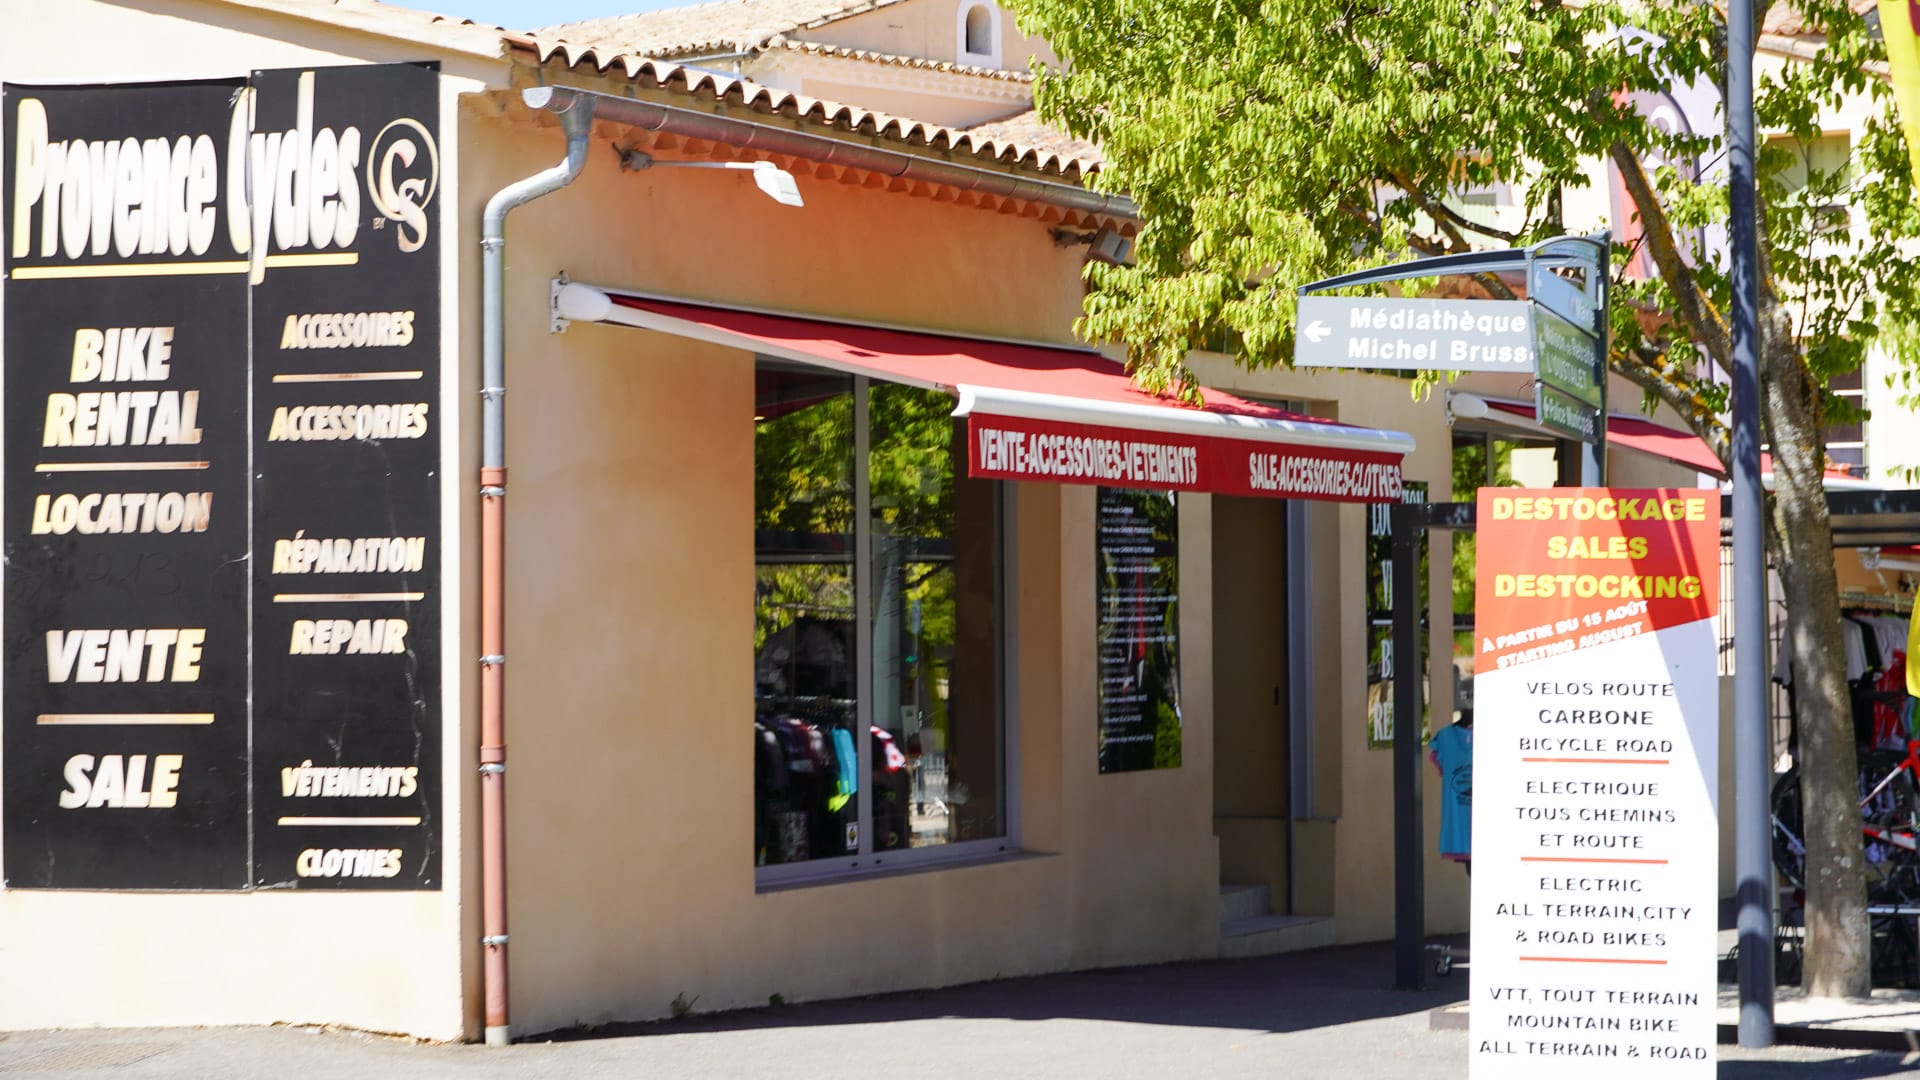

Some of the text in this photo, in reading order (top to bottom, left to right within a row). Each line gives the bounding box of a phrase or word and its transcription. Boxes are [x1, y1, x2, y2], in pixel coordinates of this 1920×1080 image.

[12, 71, 361, 285] Provence Cycles
[280, 311, 415, 350] ACCESSOIRES
[1349, 307, 1526, 337] Médiathèque
[70, 326, 175, 383] BIKE
[1347, 337, 1534, 363] Michel Bruss
[42, 390, 203, 448] RENTAL
[268, 402, 429, 442] ACCESSORIES
[31, 492, 213, 535] LOCATION
[1492, 497, 1706, 521] DESTOCKAGE
[272, 530, 426, 574] RÉPARATION
[1547, 535, 1649, 559] SALES
[1494, 574, 1701, 599] DESTOCKING
[289, 619, 409, 655] REPAIR
[1496, 624, 1555, 649] PARTIR
[1555, 617, 1579, 635] DU
[1582, 611, 1602, 627] 15
[1605, 600, 1648, 622] AOÛT
[46, 628, 206, 683] VENTE
[1496, 620, 1644, 669] STARTING AUGUST
[1527, 682, 1675, 697] VELOS ROUTE
[1538, 709, 1654, 726] CARBONE
[1519, 737, 1673, 753] BICYCLE ROAD
[59, 754, 183, 809] SALE
[281, 759, 419, 798] VÊTEMENTS
[1526, 781, 1660, 796] ELECTRIQUE
[1515, 807, 1676, 823] TOUS CHEMINS
[1540, 834, 1644, 849] ET ROUTE
[296, 848, 403, 878] CLOTHES
[1540, 877, 1642, 892] ELECTRIC
[1496, 903, 1534, 917] ALL
[1515, 929, 1666, 946] & ROAD BIKES
[1489, 987, 1698, 1006] VTT, TOUT TERRAIN
[1508, 1014, 1679, 1032] MOUNTAIN BIKE
[1479, 1040, 1708, 1060] ALL TERRAIN & ROAD
